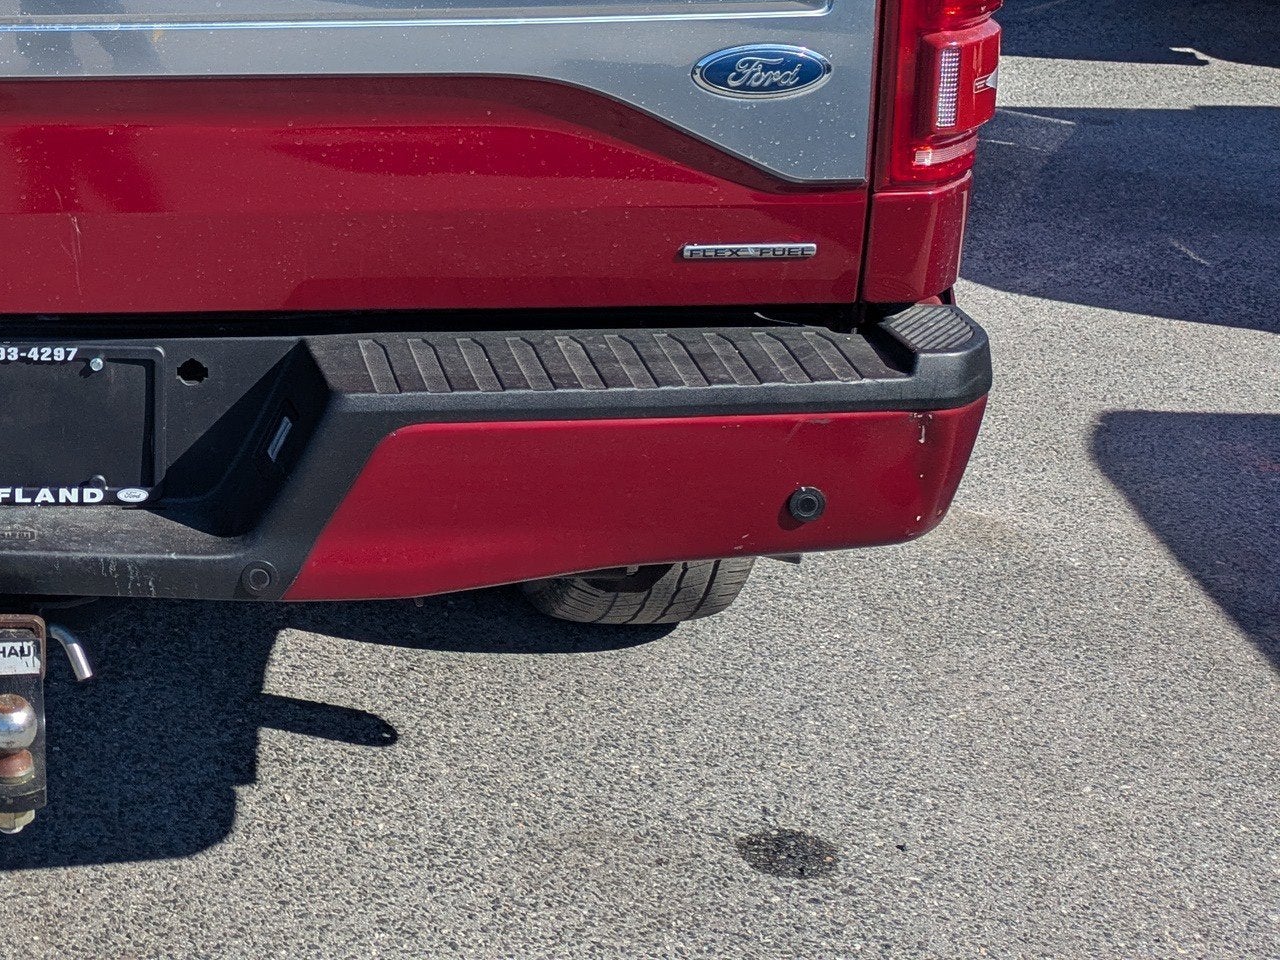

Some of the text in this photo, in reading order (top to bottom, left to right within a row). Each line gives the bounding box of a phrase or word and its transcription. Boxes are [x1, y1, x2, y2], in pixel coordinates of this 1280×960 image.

[726, 56, 803, 88] Ford
[688, 246, 812, 259] FLEX FUEL
